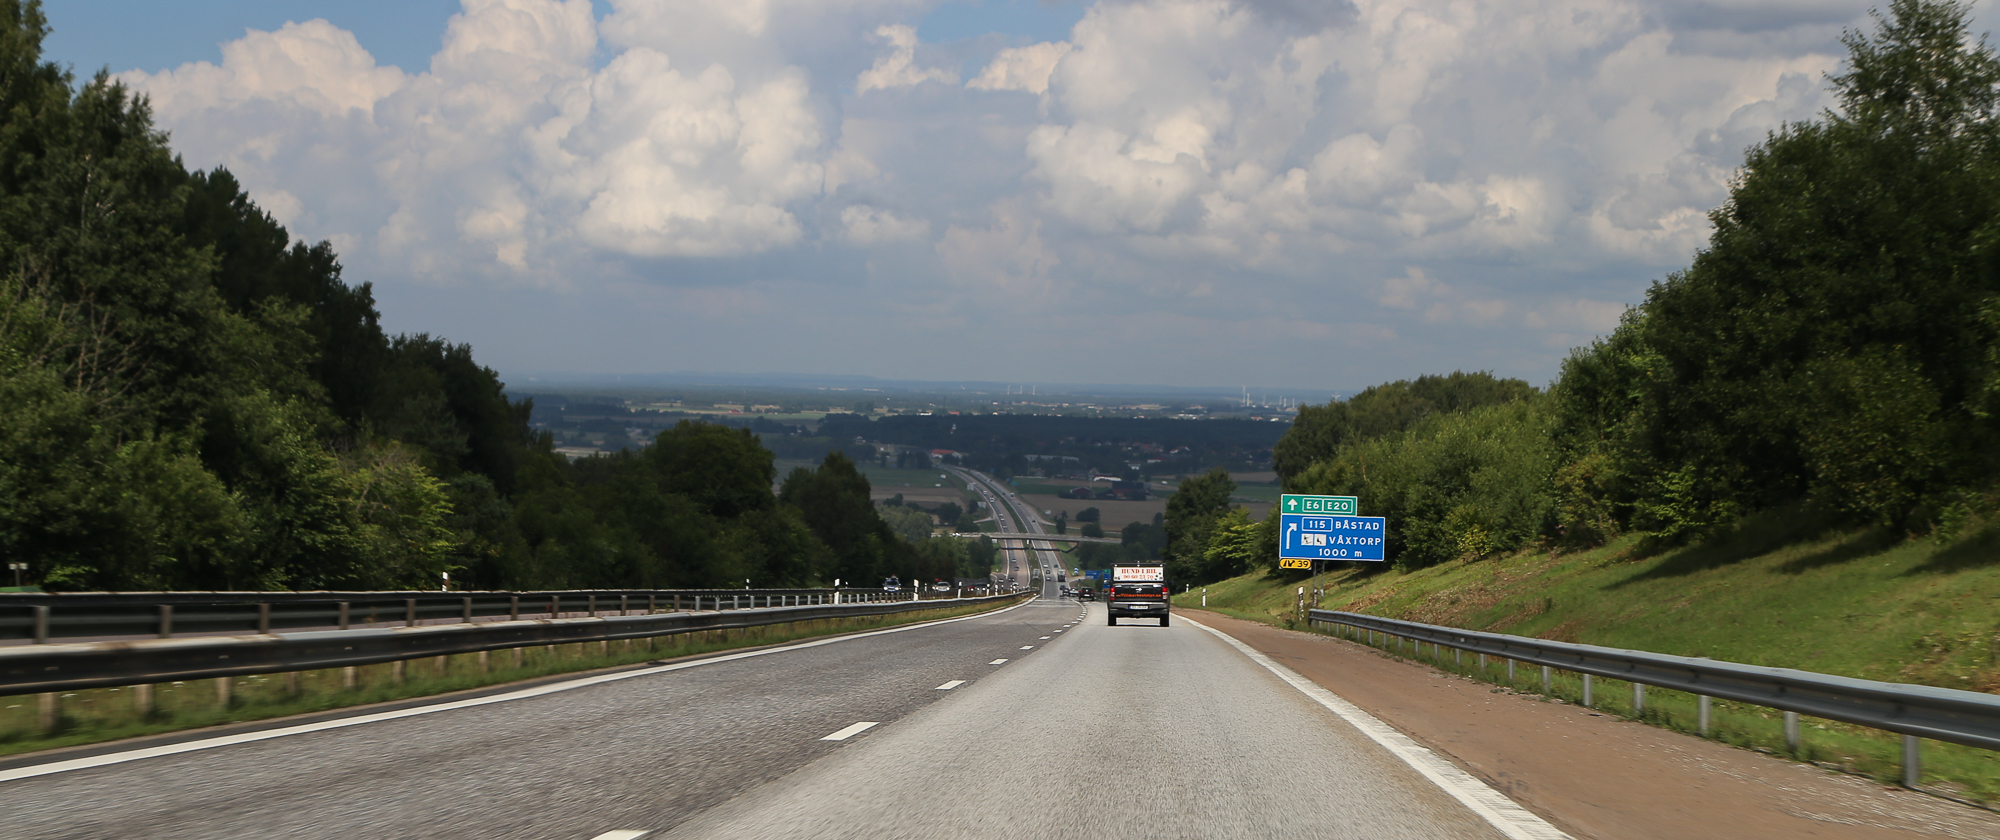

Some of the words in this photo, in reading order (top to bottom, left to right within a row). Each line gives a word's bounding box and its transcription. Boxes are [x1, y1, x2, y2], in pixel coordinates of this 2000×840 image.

[1306, 501, 1320, 509] E6
[1327, 502, 1349, 510] E20
[1309, 520, 1326, 528] 115
[1335, 519, 1380, 530] BÅSTAD
[1329, 535, 1381, 545] VÅXTORP
[1318, 548, 1348, 557] 1000
